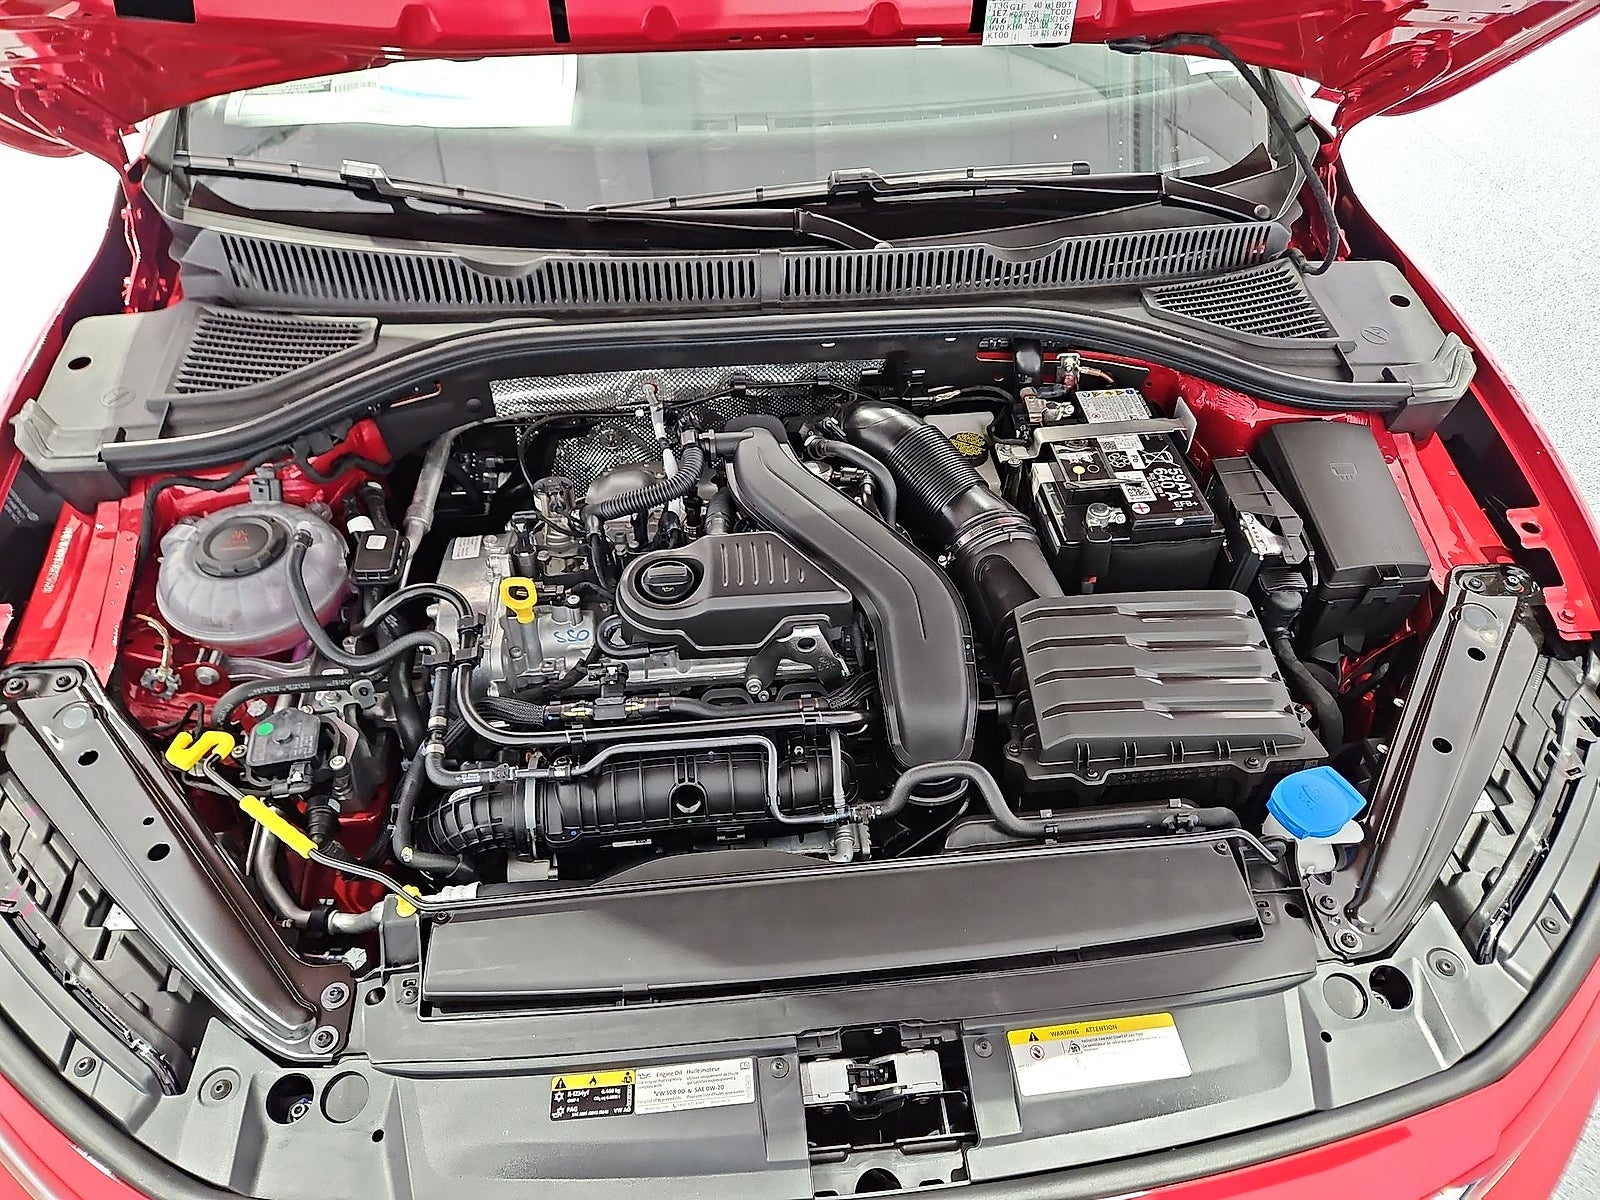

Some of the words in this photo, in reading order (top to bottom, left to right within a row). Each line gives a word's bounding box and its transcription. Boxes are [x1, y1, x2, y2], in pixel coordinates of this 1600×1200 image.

[1153, 468, 1176, 489] 640
[1167, 468, 1195, 498] 59Ah
[1049, 1029, 1079, 1038] WARNING
[1085, 1024, 1118, 1034] ATTENTION
